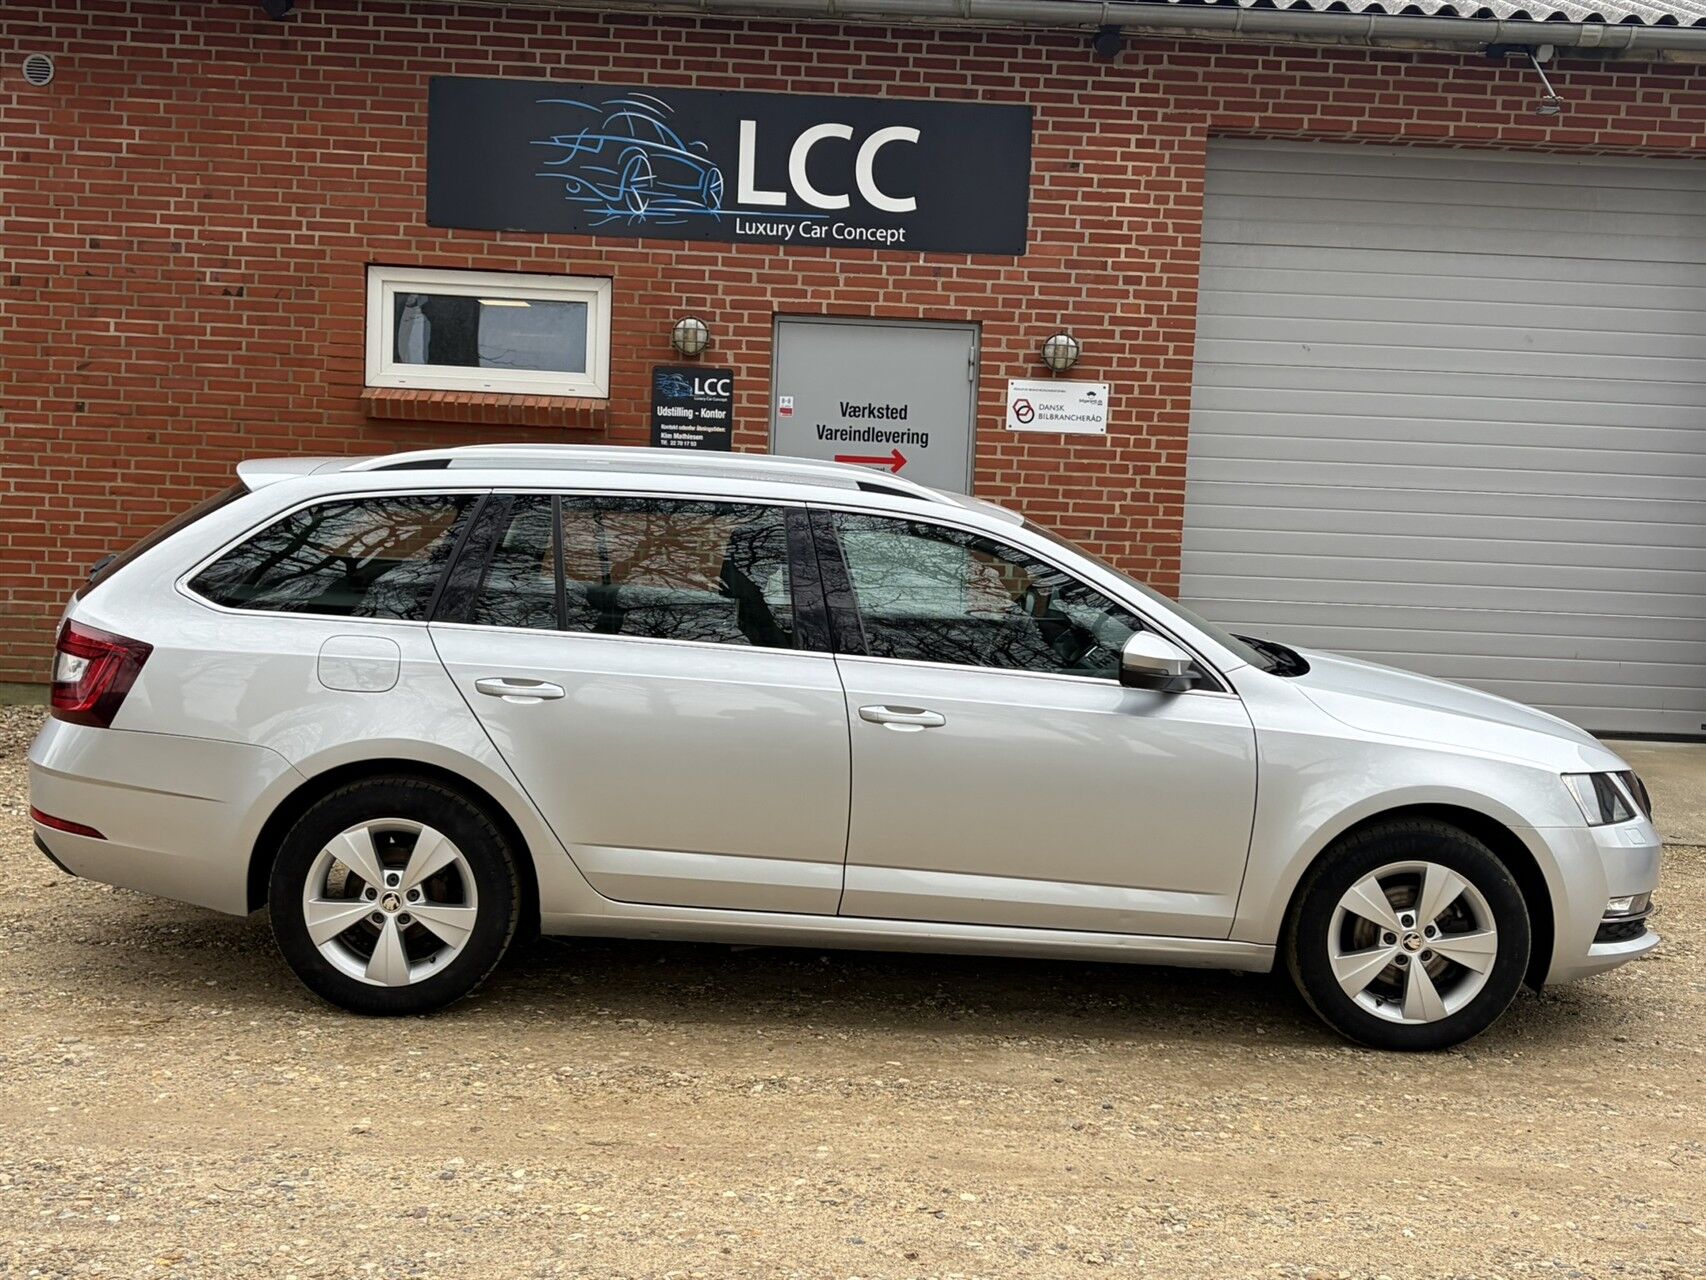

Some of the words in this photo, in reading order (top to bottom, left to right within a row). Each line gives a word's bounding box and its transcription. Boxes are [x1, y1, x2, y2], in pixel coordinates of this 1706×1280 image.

[737, 119, 921, 213] LCC
[735, 218, 795, 241] Luxury
[799, 221, 829, 238] Car
[832, 222, 906, 246] Concept
[694, 377, 731, 396] LCC
[657, 406, 694, 420] Udstilling
[700, 408, 727, 419] Kontor
[840, 401, 908, 420] Værksted
[1039, 404, 1065, 412] DANSK
[816, 424, 929, 449] Vareindlevering
